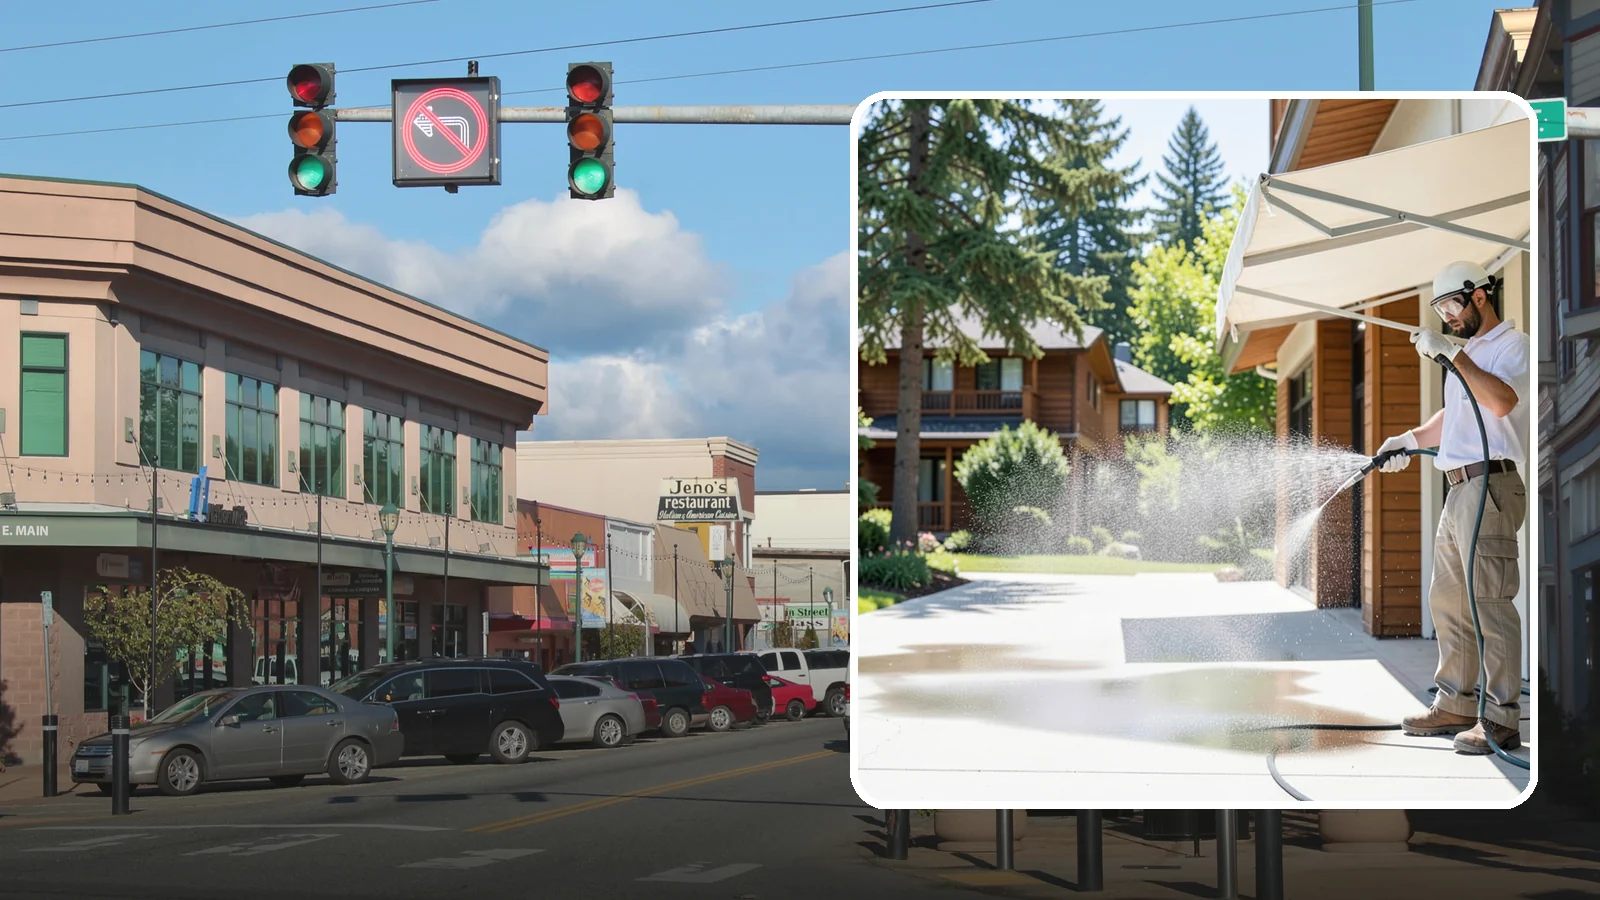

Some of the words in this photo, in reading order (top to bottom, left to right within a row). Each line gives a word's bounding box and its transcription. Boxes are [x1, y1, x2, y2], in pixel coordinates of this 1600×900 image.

[670, 480, 727, 494] Jeno's
[665, 497, 731, 509] restaurant
[658, 510, 682, 520] Italian
[686, 510, 715, 519] American
[715, 509, 737, 519] Cuisine
[2, 525, 13, 536] E.
[15, 525, 49, 536] MAIN
[797, 607, 829, 617] Street
